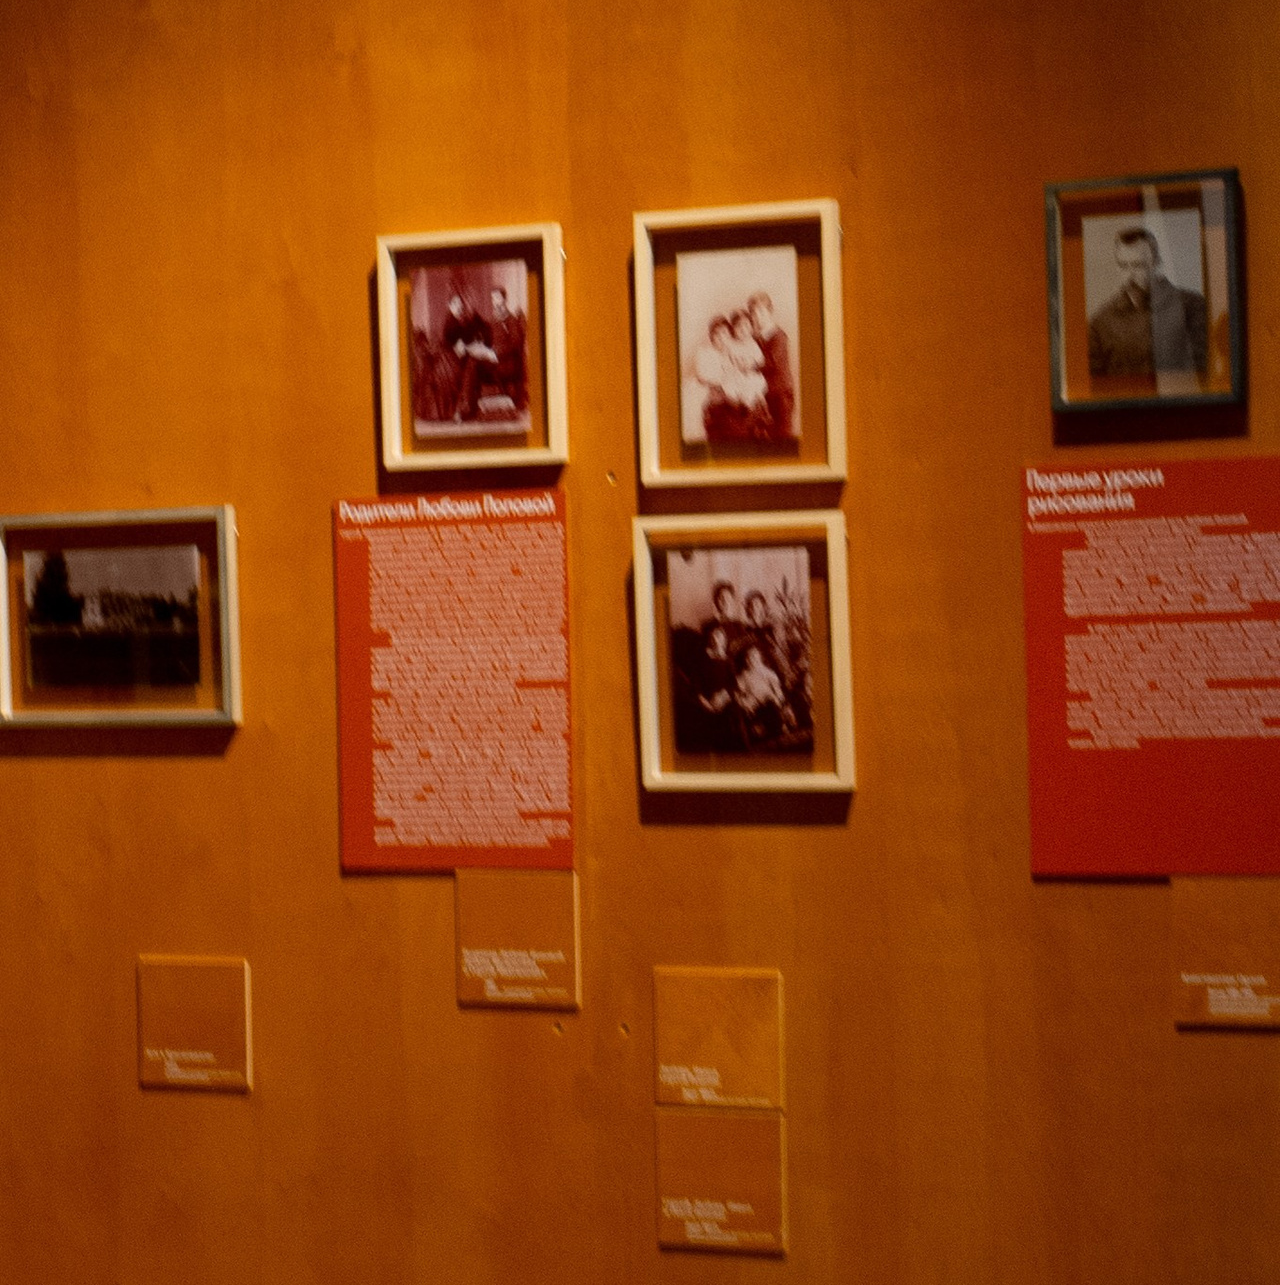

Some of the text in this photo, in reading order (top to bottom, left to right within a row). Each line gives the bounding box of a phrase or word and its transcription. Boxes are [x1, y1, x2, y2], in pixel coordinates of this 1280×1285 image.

[1026, 468, 1165, 495] Первые уроки
[339, 492, 556, 524] Родители Любови Поповой
[1027, 491, 1136, 521] рисования
